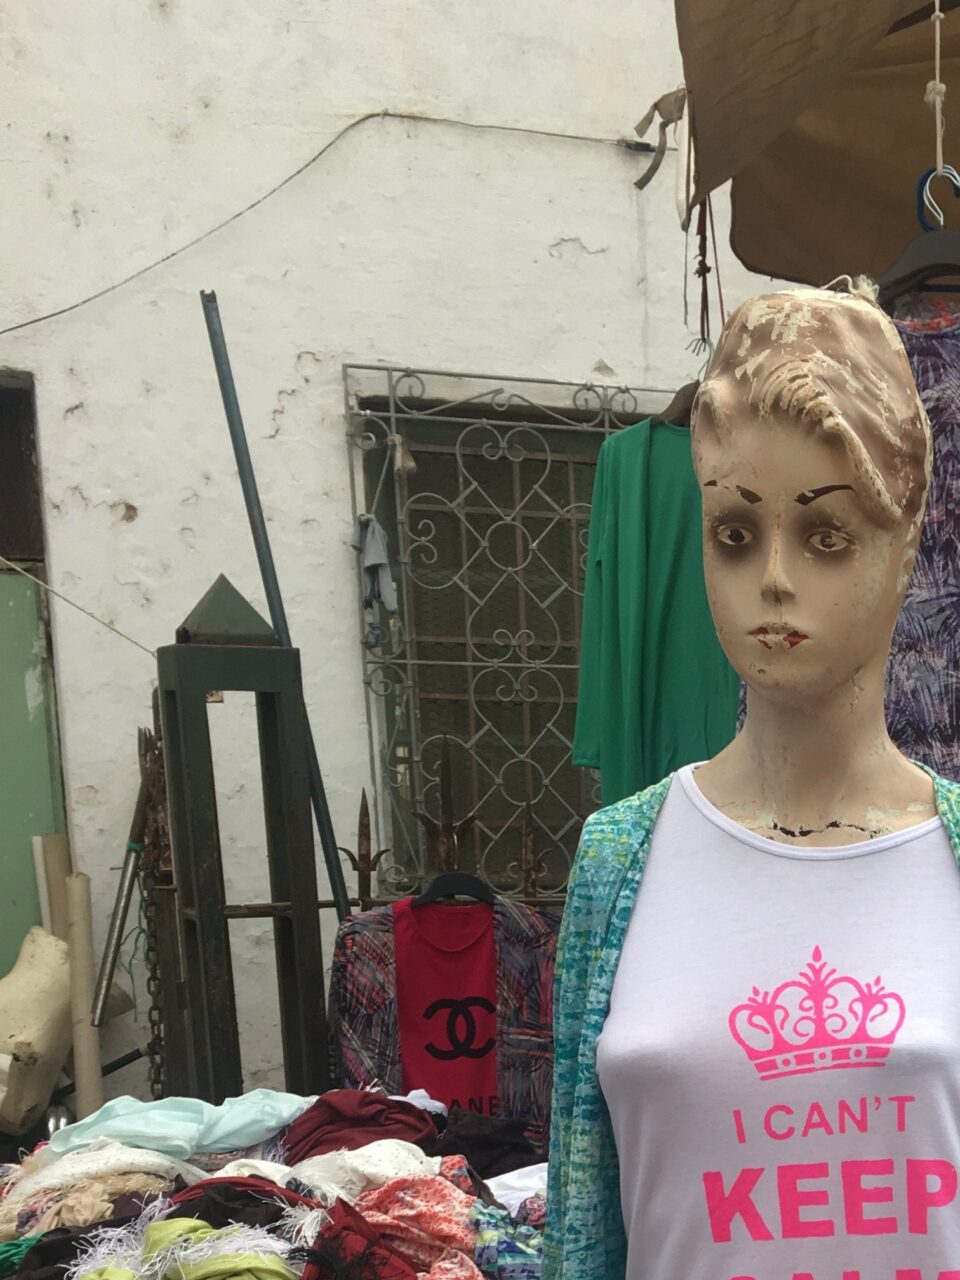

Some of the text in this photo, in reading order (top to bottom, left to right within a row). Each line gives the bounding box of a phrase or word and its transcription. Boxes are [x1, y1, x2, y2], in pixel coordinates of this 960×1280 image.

[731, 1094, 917, 1146] I CAN'T
[701, 1157, 959, 1244] KEEP
